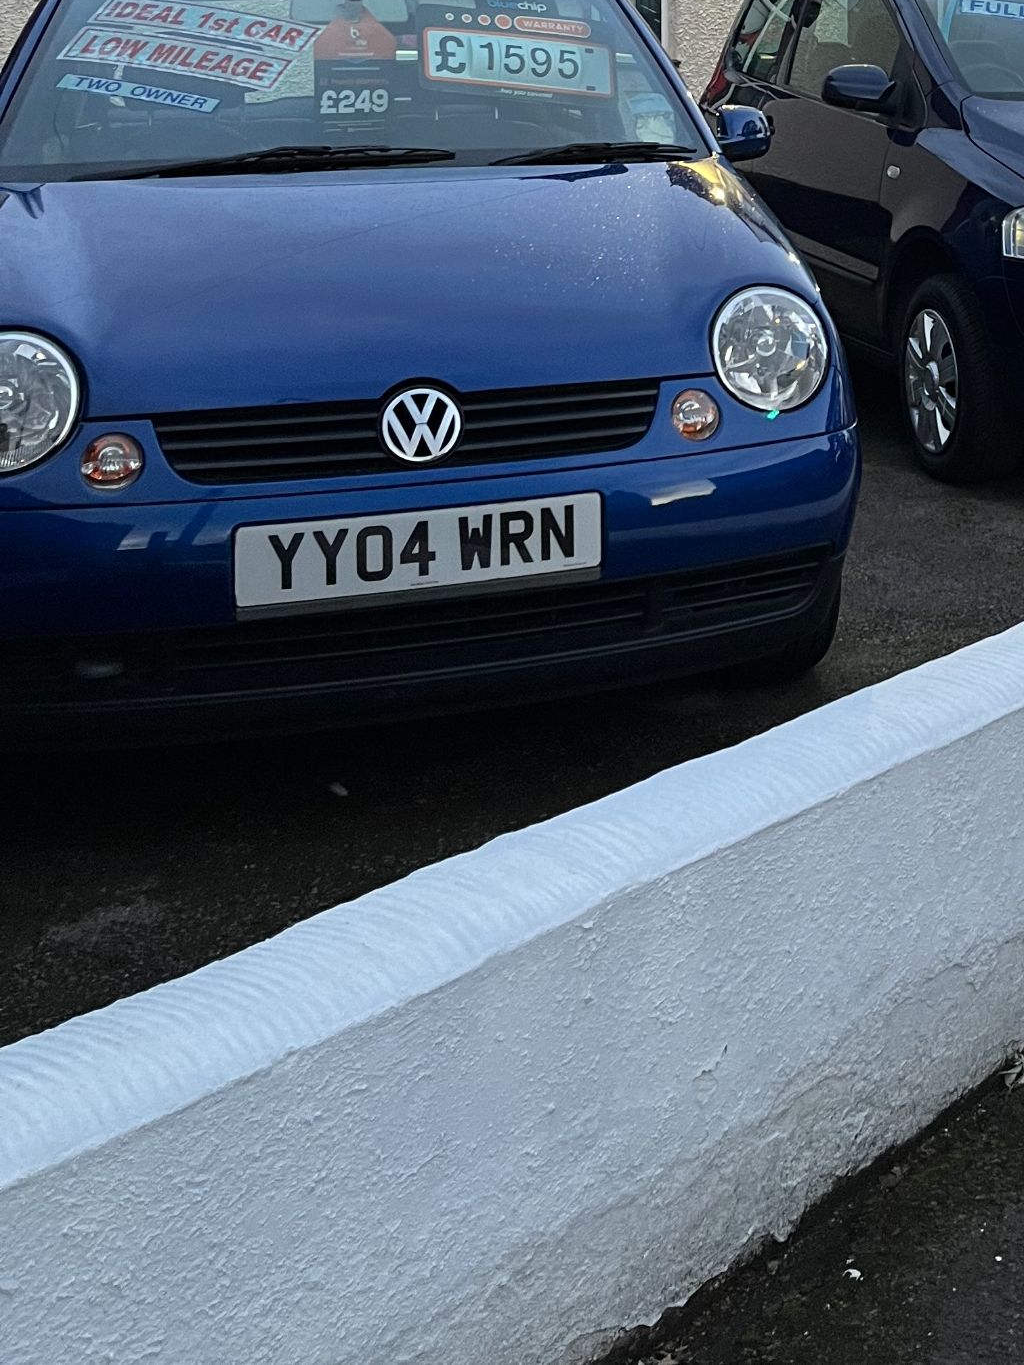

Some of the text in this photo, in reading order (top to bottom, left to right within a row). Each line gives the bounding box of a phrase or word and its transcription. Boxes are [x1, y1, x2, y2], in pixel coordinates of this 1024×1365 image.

[105, 0, 305, 46] IDEAL 1st CAR
[521, 19, 585, 34] WARRANTY
[80, 34, 274, 82] LOW MILEAGE
[435, 35, 579, 80] £1595
[73, 75, 208, 110] TWO OWNER
[320, 88, 389, 114] £249
[268, 504, 575, 590] YY04 WRN
